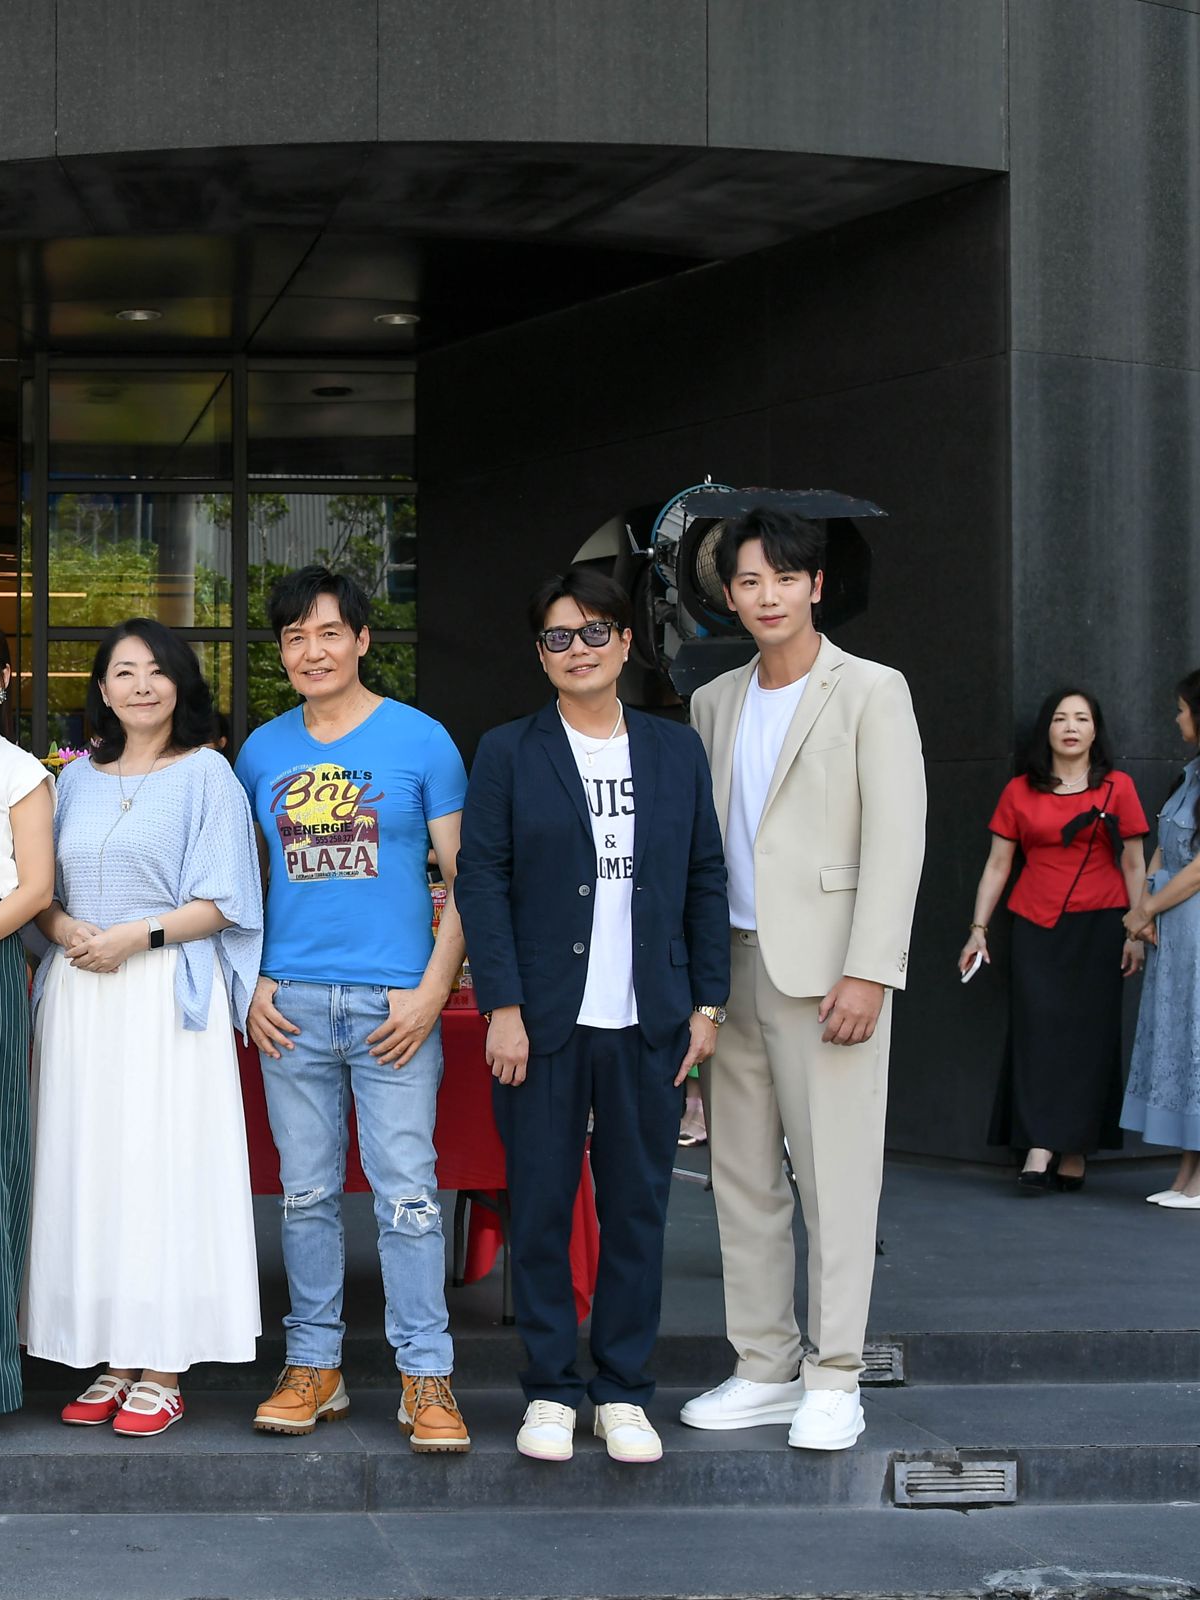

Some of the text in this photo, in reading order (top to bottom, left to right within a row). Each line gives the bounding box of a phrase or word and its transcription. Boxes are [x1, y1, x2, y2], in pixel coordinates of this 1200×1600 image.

[321, 770, 373, 782] KARL'S
[270, 771, 385, 821] Bay
[604, 834, 617, 849] &
[287, 845, 378, 878] PLAZA
